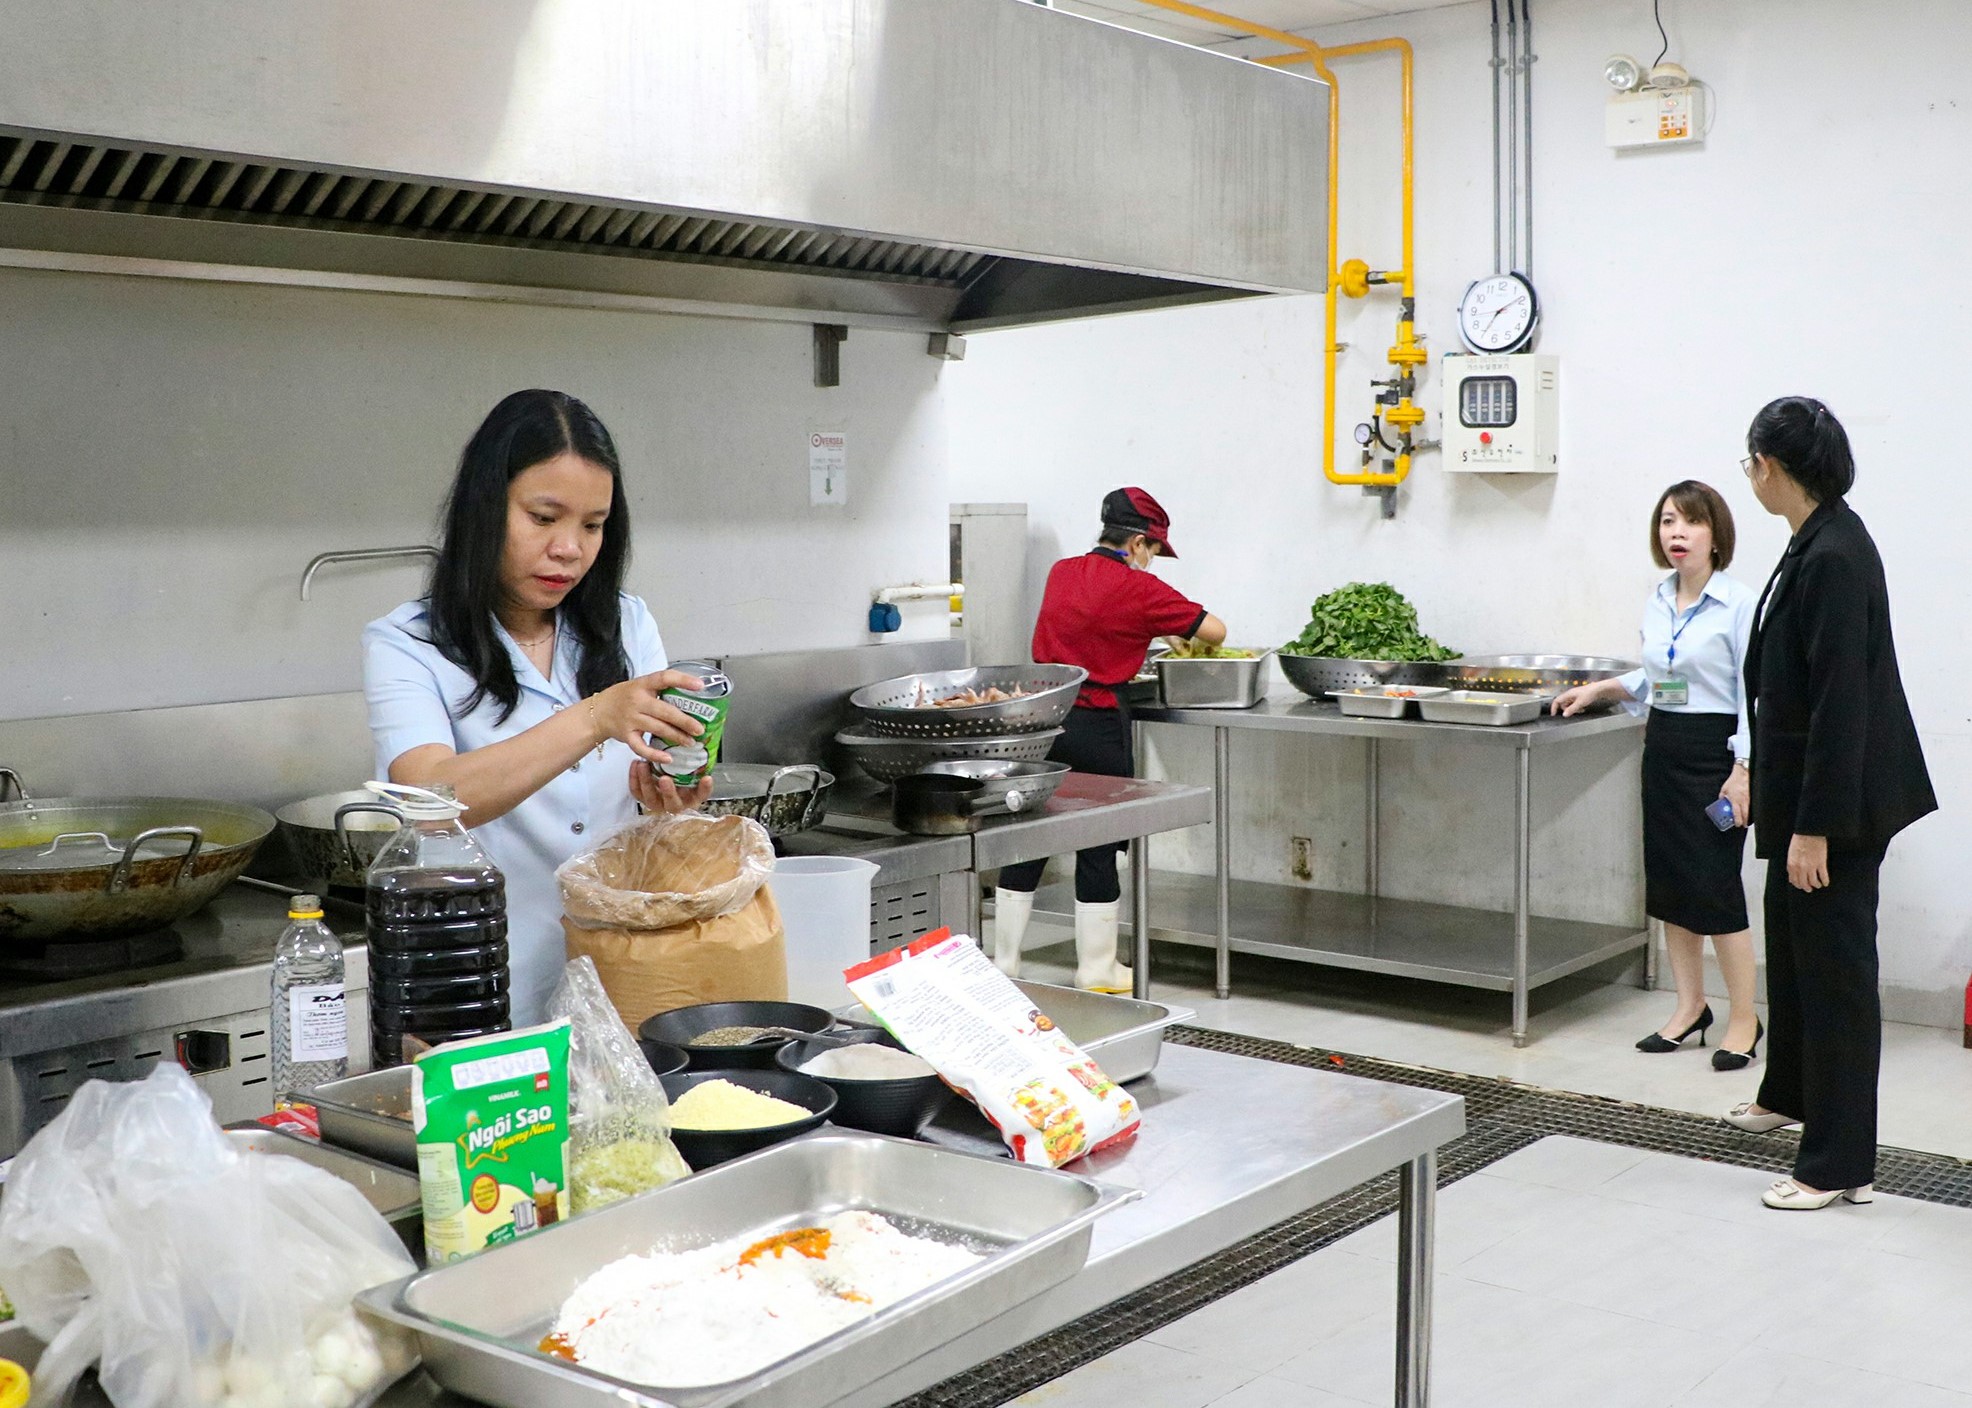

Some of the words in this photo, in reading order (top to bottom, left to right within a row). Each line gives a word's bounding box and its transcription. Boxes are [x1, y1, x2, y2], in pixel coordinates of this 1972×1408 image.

[1486, 285, 1494, 295] 11
[1498, 281, 1508, 291] 12
[1476, 294, 1485, 304] 10
[1518, 295, 1526, 305] 2
[1471, 306, 1477, 316] 9
[1520, 308, 1527, 318] 3
[1472, 320, 1479, 330] 8
[1514, 322, 1521, 331] 4
[1491, 333, 1498, 343] 6
[1504, 330, 1511, 340] 5
[469, 1113, 511, 1152] Ngôi
[515, 1105, 552, 1129] Sao
